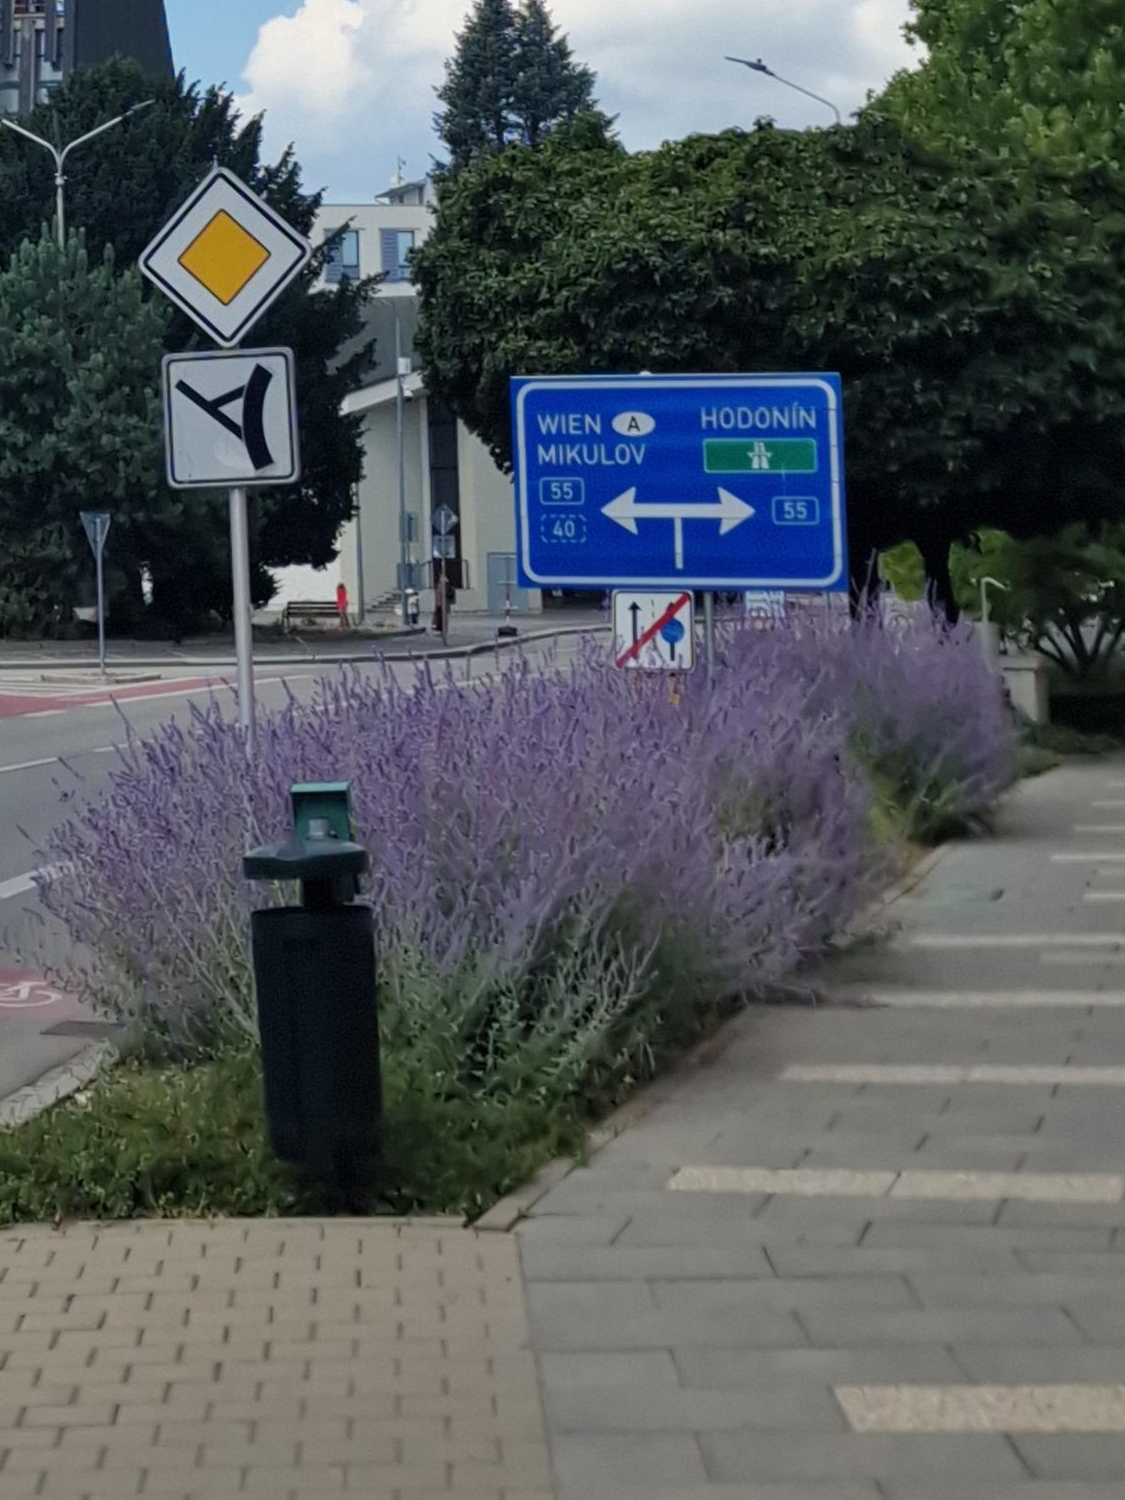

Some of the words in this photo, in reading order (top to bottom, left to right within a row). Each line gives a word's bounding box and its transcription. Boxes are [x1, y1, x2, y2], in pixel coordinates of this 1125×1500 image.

[537, 413, 602, 436] WIEN
[627, 415, 641, 432] A
[700, 401, 817, 430] HODONÍN
[537, 443, 646, 466] MIKULOV
[550, 481, 574, 500] 55
[783, 501, 808, 520] 55
[552, 519, 576, 538] 40
